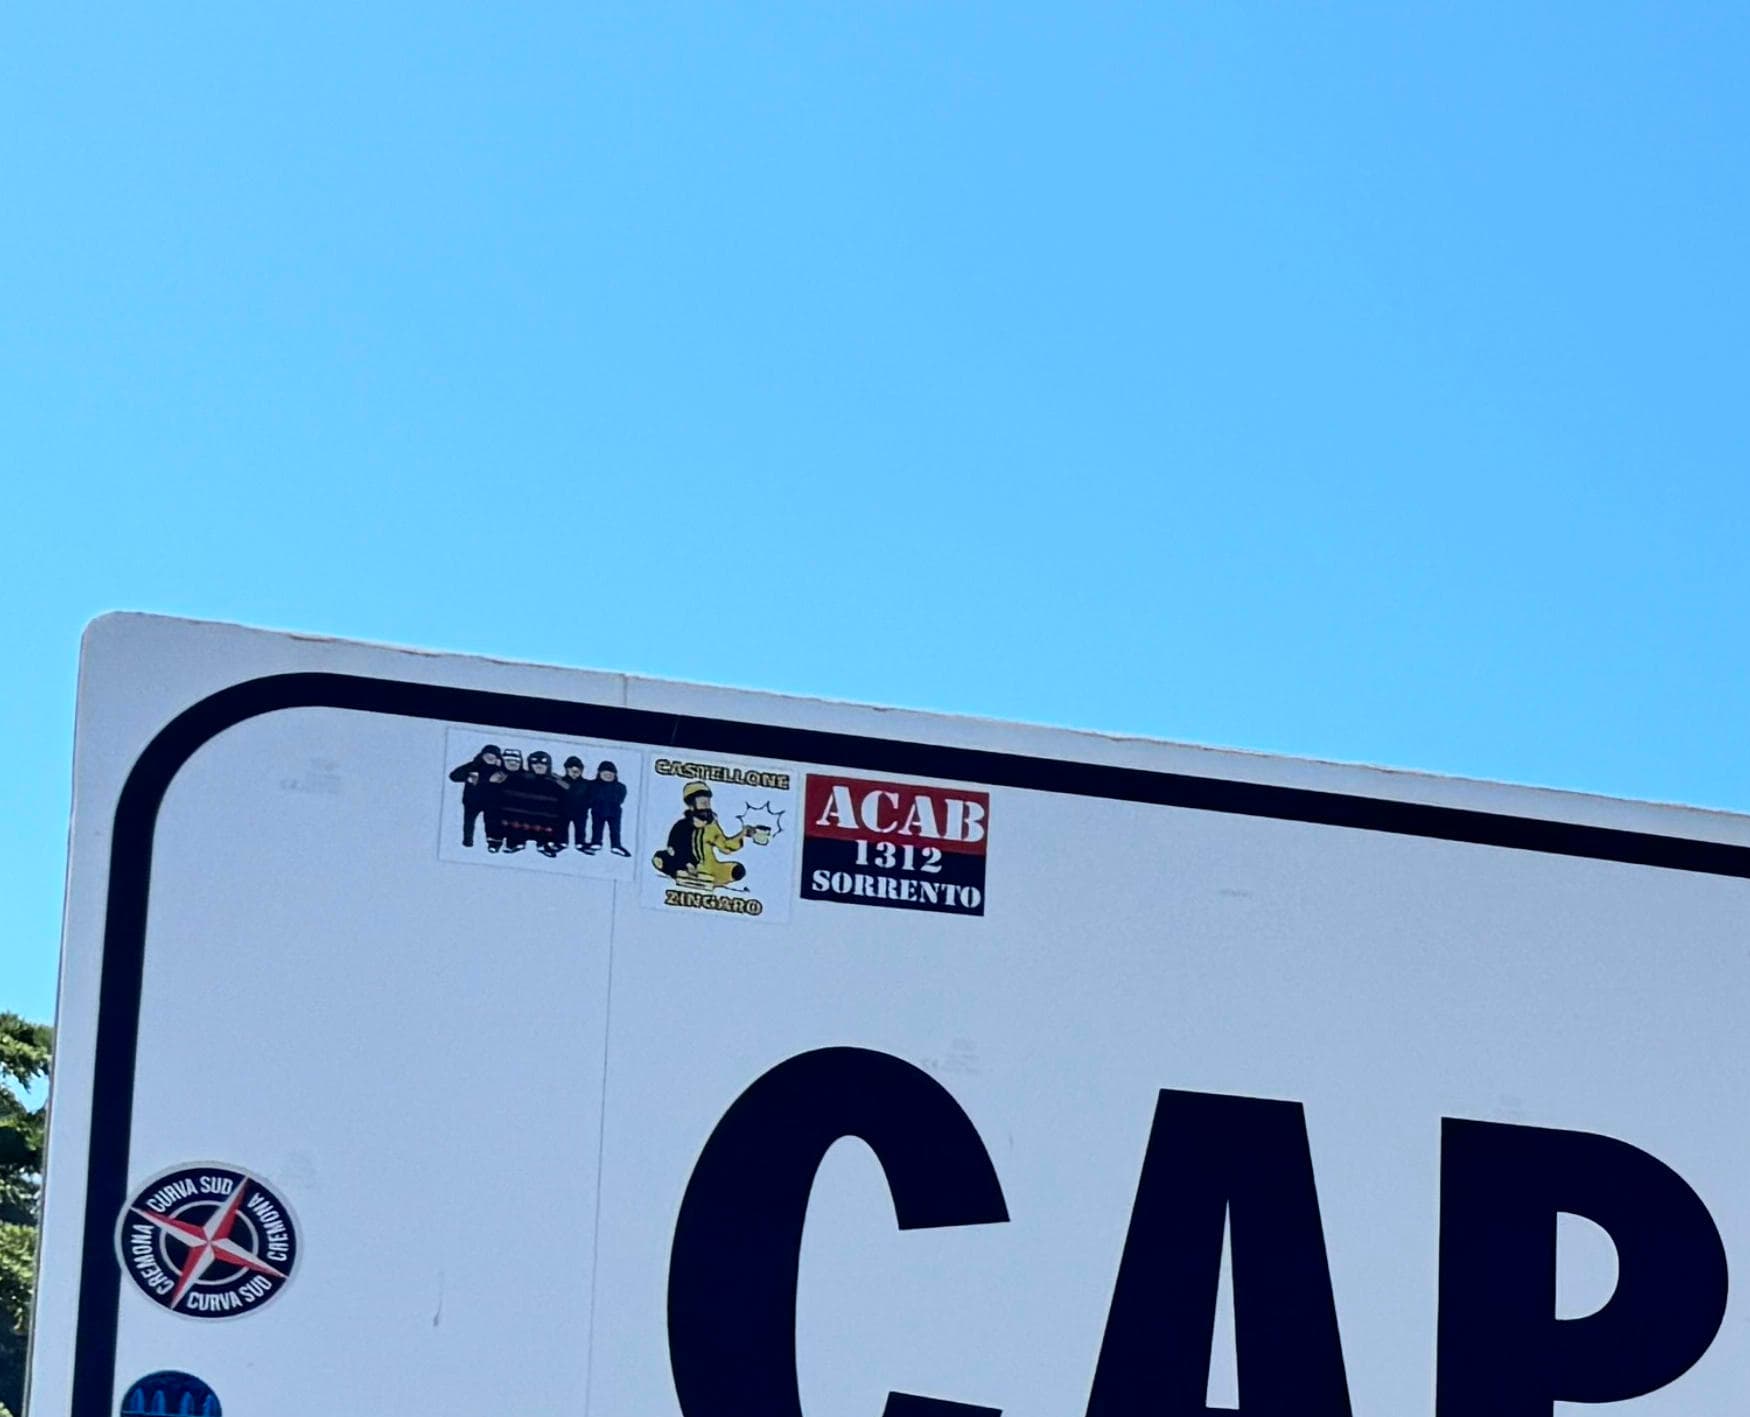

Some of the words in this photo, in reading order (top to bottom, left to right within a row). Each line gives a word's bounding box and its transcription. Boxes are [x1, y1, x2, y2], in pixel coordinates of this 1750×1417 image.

[655, 759, 790, 790] CASTELLONE
[816, 785, 985, 843] ACAB
[854, 840, 943, 873] 1312
[664, 890, 762, 916] ZINGARO
[811, 869, 982, 909] SORRENTO
[146, 1178, 198, 1213] CURVA
[200, 1176, 233, 1195] SUD
[247, 1192, 289, 1262] CREMONA
[131, 1224, 175, 1295] CREMONA
[187, 1291, 243, 1311] CURVA
[239, 1275, 273, 1302] SUD
